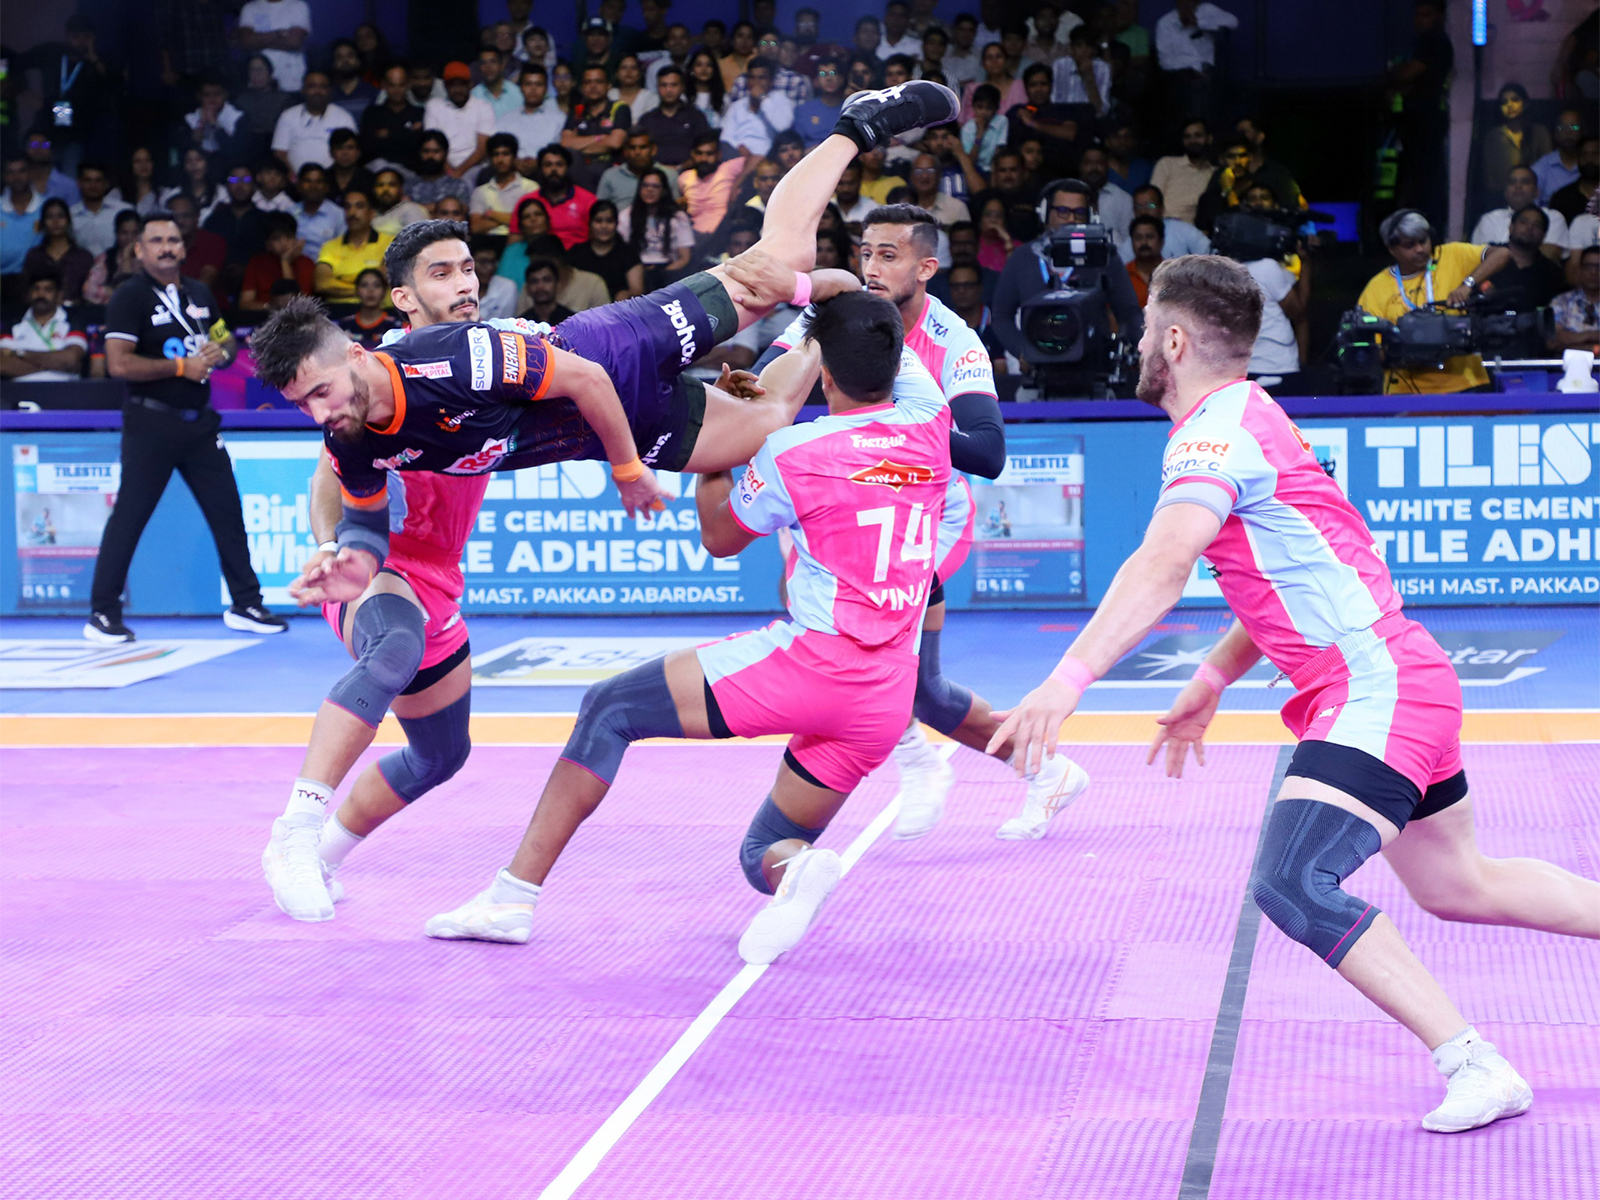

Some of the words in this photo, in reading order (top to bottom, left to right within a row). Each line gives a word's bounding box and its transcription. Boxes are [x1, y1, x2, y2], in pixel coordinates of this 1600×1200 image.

[501, 334, 520, 383] ENERZAL
[1010, 457, 1070, 469] TILESTIX
[242, 493, 309, 533] Birl
[504, 509, 627, 533] CEMENT
[634, 508, 702, 532] BAS
[1366, 498, 1472, 522] WHITE
[248, 533, 317, 574] Whi
[856, 503, 932, 583] 74
[1370, 529, 1469, 563] TILE
[468, 588, 527, 604] MAST.
[533, 587, 616, 604] PAKKAD
[620, 586, 745, 604] JABARDAST.
[1441, 577, 1504, 595] MAST.
[1511, 576, 1600, 594] PAKKAD
